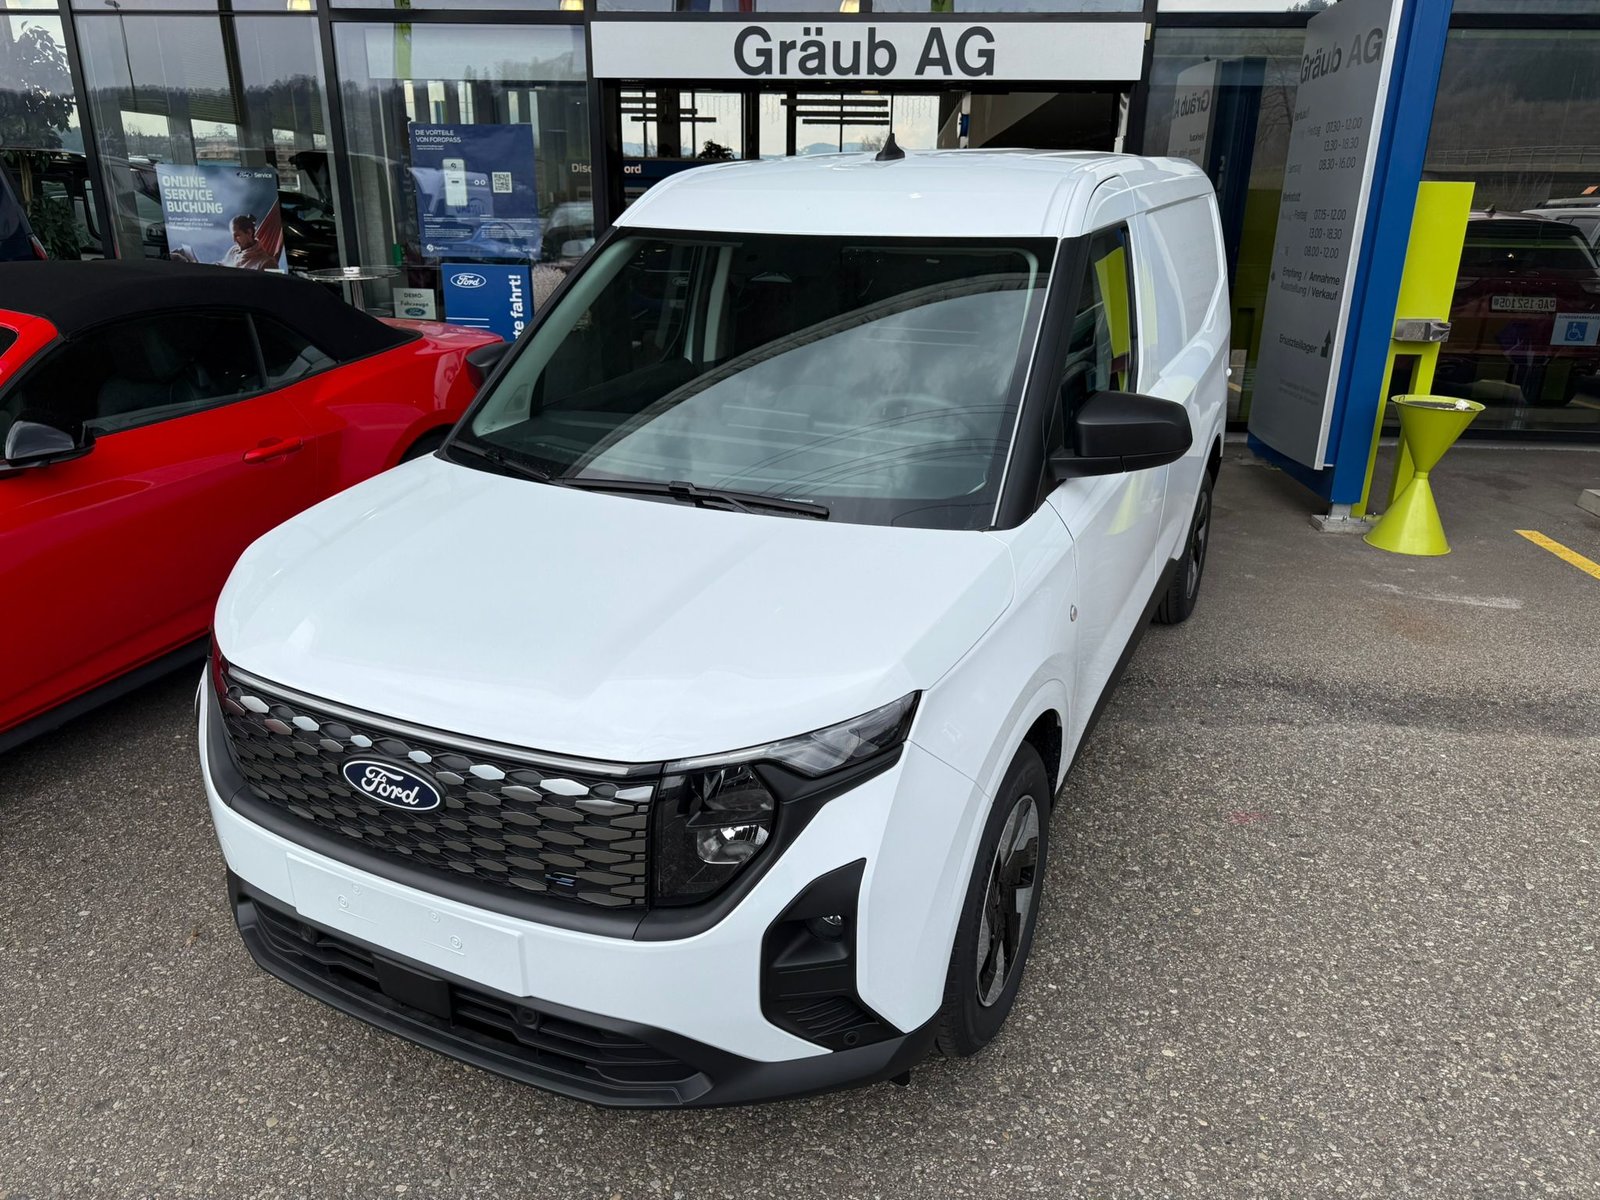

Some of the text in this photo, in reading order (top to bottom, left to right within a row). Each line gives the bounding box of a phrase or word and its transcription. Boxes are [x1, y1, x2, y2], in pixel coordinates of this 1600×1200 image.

[734, 25, 996, 77] Gräub AG
[1300, 27, 1384, 84] Gräub AG
[162, 175, 207, 188] ONLINE
[164, 188, 213, 201] SERVICE
[166, 201, 223, 214] BUCHUNG
[456, 274, 480, 287] Ford
[1309, 271, 1340, 286] Annahme
[508, 274, 524, 318] fahrt!
[1311, 287, 1338, 301] Verkauf
[1279, 333, 1317, 354] Ersatzteillager
[361, 766, 420, 805] Ford
